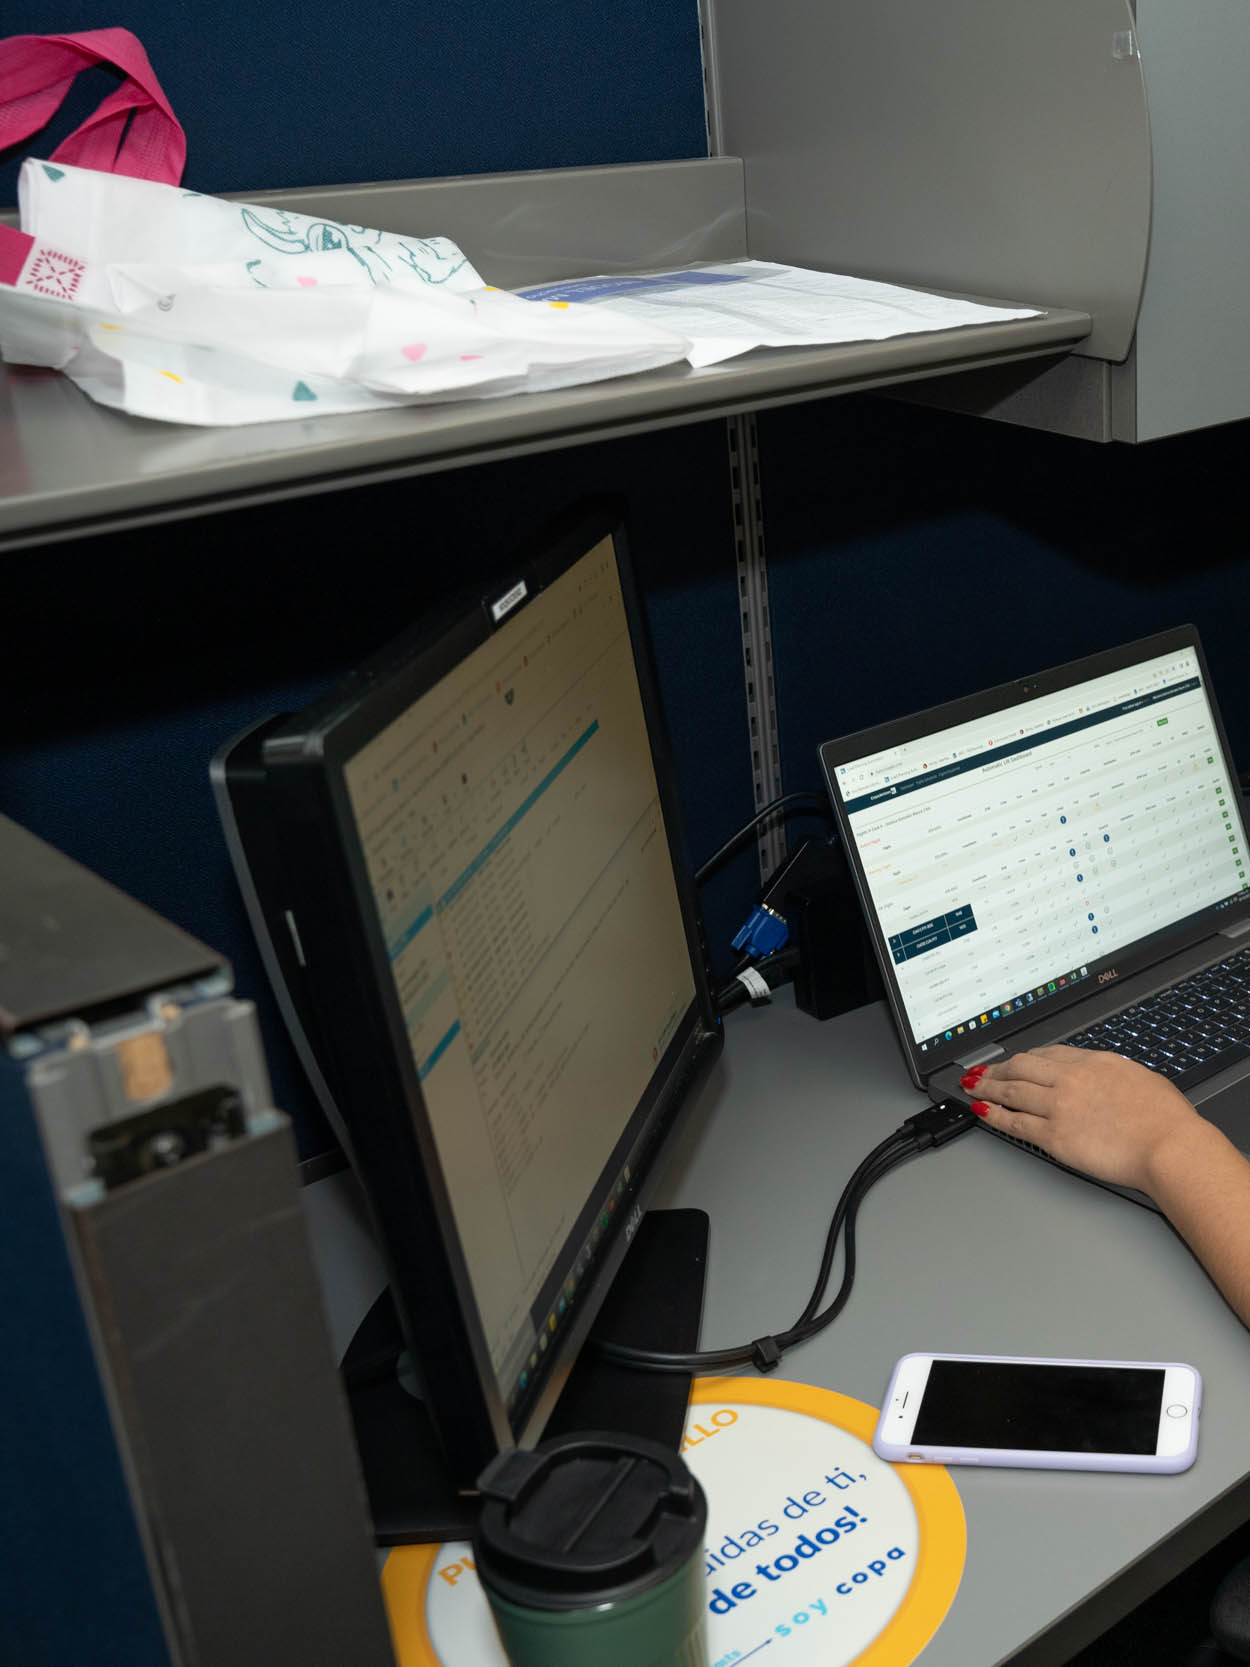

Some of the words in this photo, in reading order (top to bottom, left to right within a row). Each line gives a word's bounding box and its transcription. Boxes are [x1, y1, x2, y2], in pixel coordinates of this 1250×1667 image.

[1098, 968, 1120, 984] DELL
[783, 1490, 827, 1520] de
[824, 1466, 868, 1490] ti,
[708, 1581, 758, 1616] de
[756, 1505, 868, 1582] todos!
[774, 1597, 828, 1638] soy
[836, 1546, 907, 1596] copa
